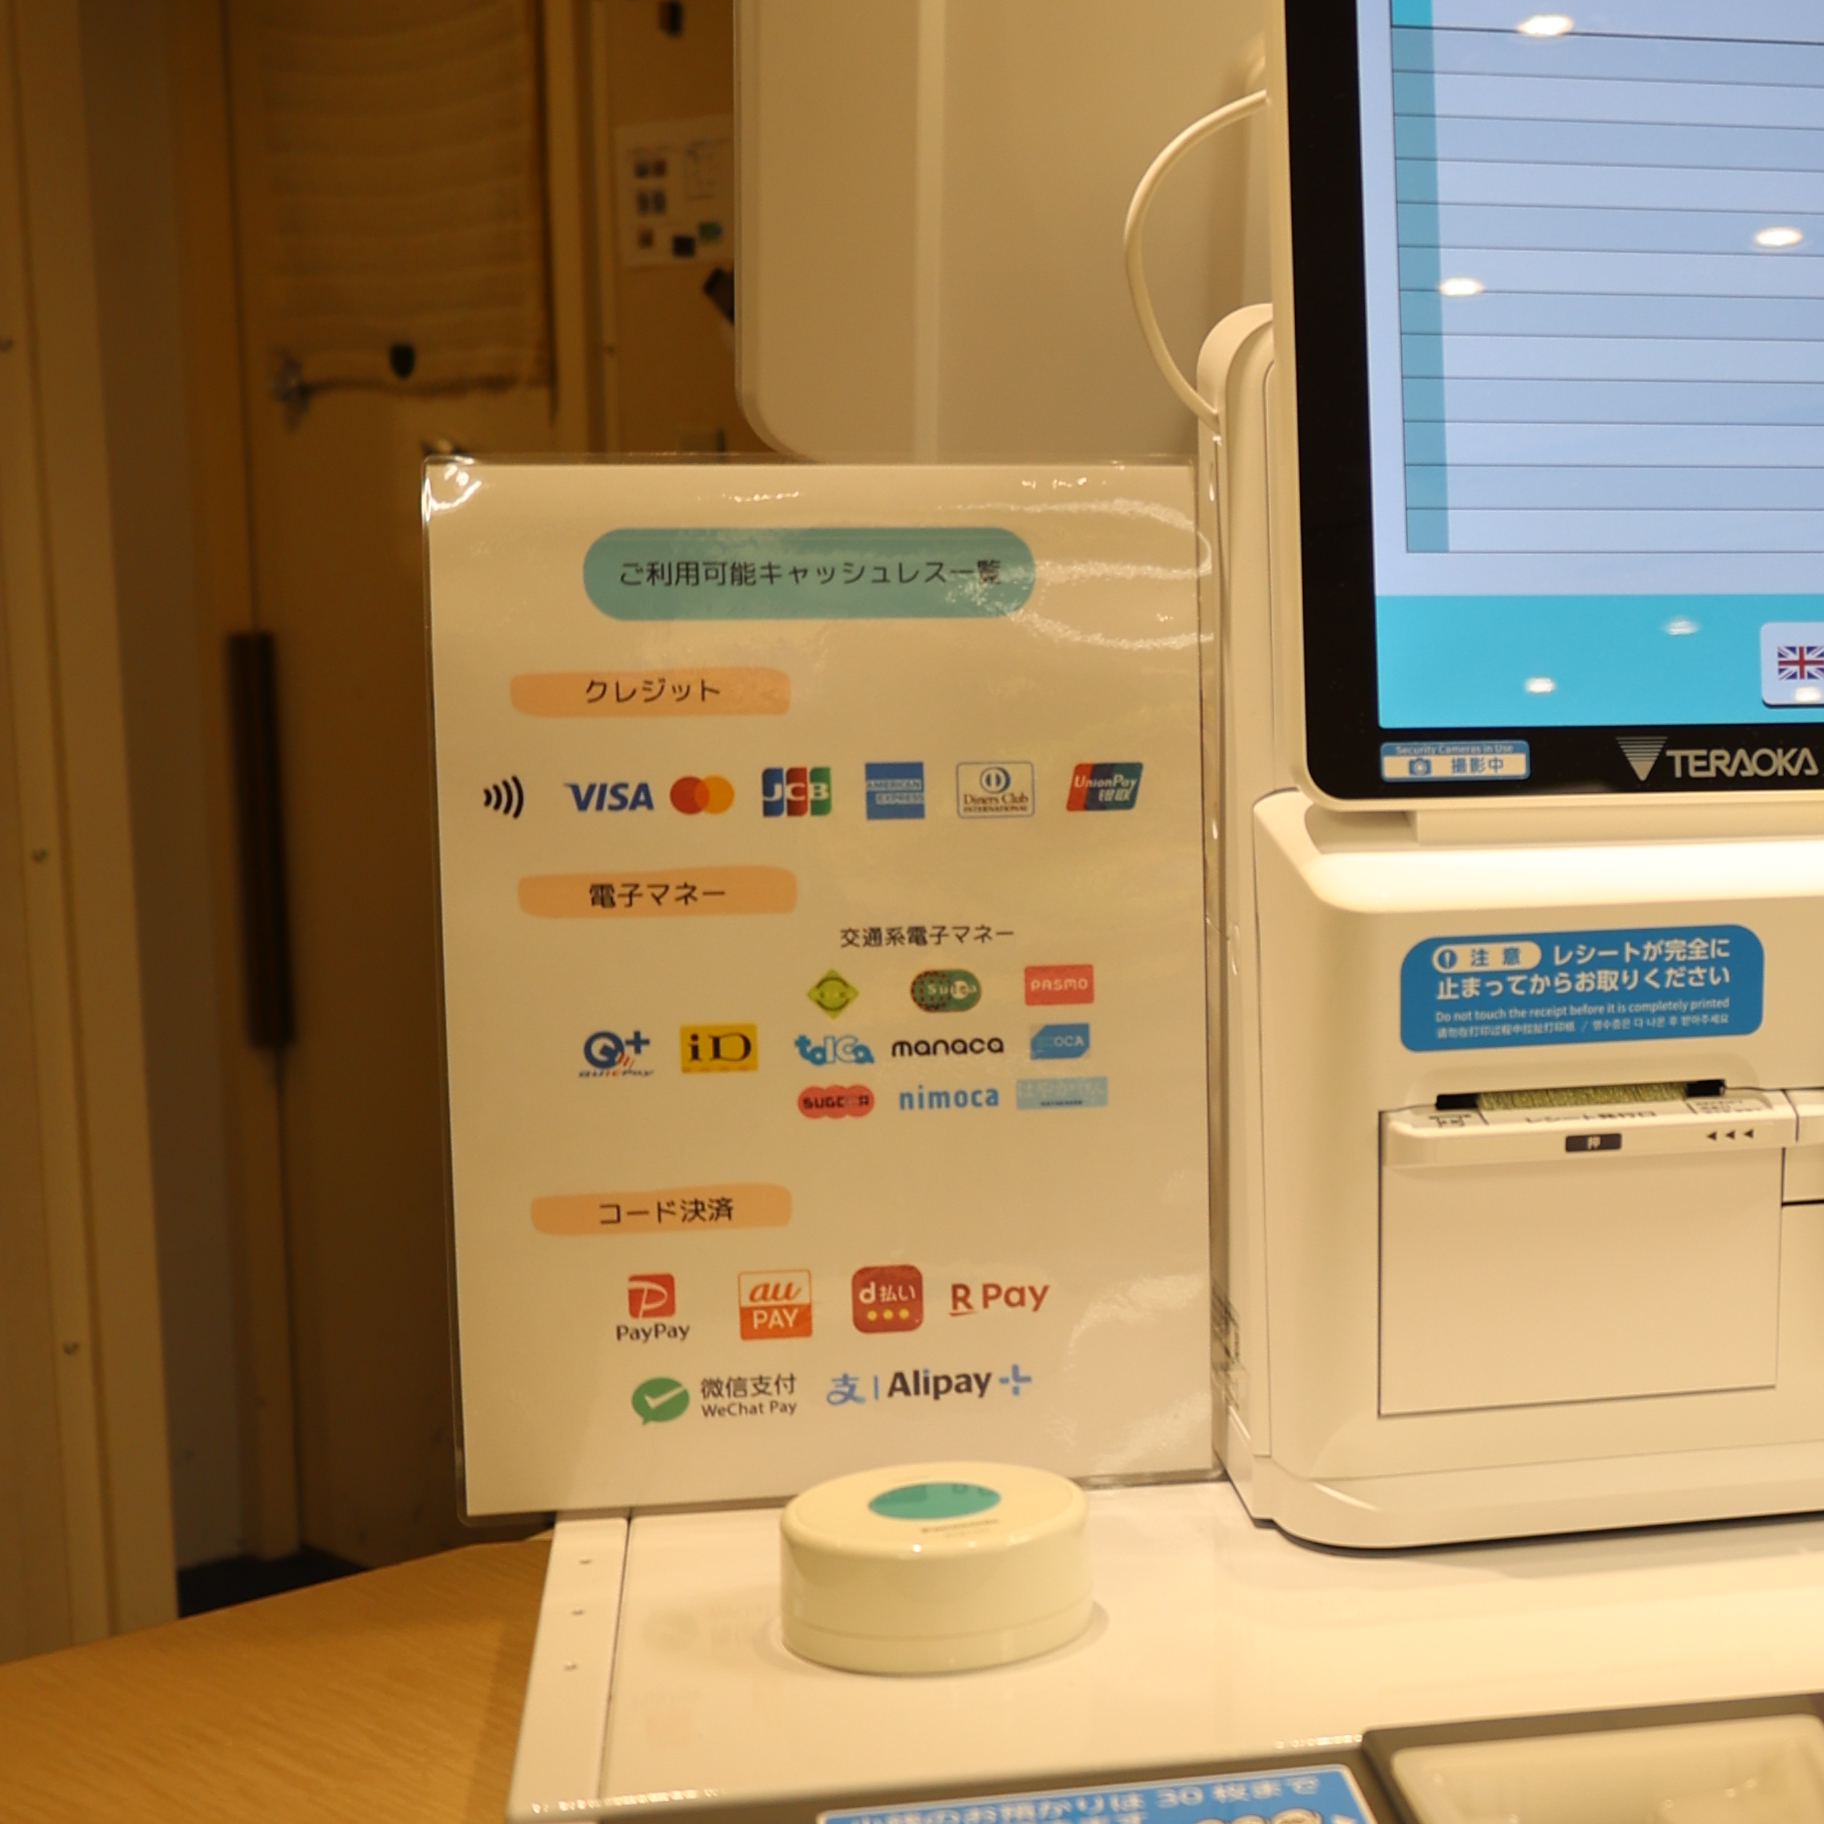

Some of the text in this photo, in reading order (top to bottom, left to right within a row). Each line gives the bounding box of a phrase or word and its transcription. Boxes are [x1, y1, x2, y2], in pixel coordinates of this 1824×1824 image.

[618, 560, 1001, 587] ご利用可能キャッシュレス一覧
[585, 678, 721, 704] クレジット
[1665, 748, 1820, 778] TERAOKA
[1074, 774, 1137, 791] UnionPay
[563, 782, 654, 812] VISA
[963, 793, 1029, 805] Diners Club
[589, 882, 726, 909] 電子マネー
[840, 925, 1014, 948] 交通系電子マネー
[1554, 938, 1730, 966] レシートが完全に
[1030, 977, 1088, 991] PASMO
[1436, 966, 1730, 1000] 止まってからお取りください
[1436, 1011, 1451, 1022] Do
[1454, 1010, 1472, 1021] not
[1474, 1008, 1506, 1020] touch
[1509, 1007, 1526, 1018] the
[1529, 1006, 1567, 1018] receipt
[1569, 1003, 1605, 1015] before
[1628, 999, 1688, 1013] completely
[1690, 997, 1730, 1011] printed
[688, 1032, 752, 1062] iD
[891, 1037, 1005, 1057] manaca
[899, 1085, 999, 1110] nimoca
[600, 1197, 733, 1224] コード決済
[748, 1280, 802, 1303] au
[858, 1281, 917, 1305] d払い
[950, 1282, 1050, 1315] R Pay
[752, 1308, 799, 1330] PAY
[616, 1323, 690, 1344] PayPay
[700, 1373, 797, 1399] 微信支付
[701, 1400, 797, 1419] WeChat Pay
[1156, 1785, 1204, 1809] 30
